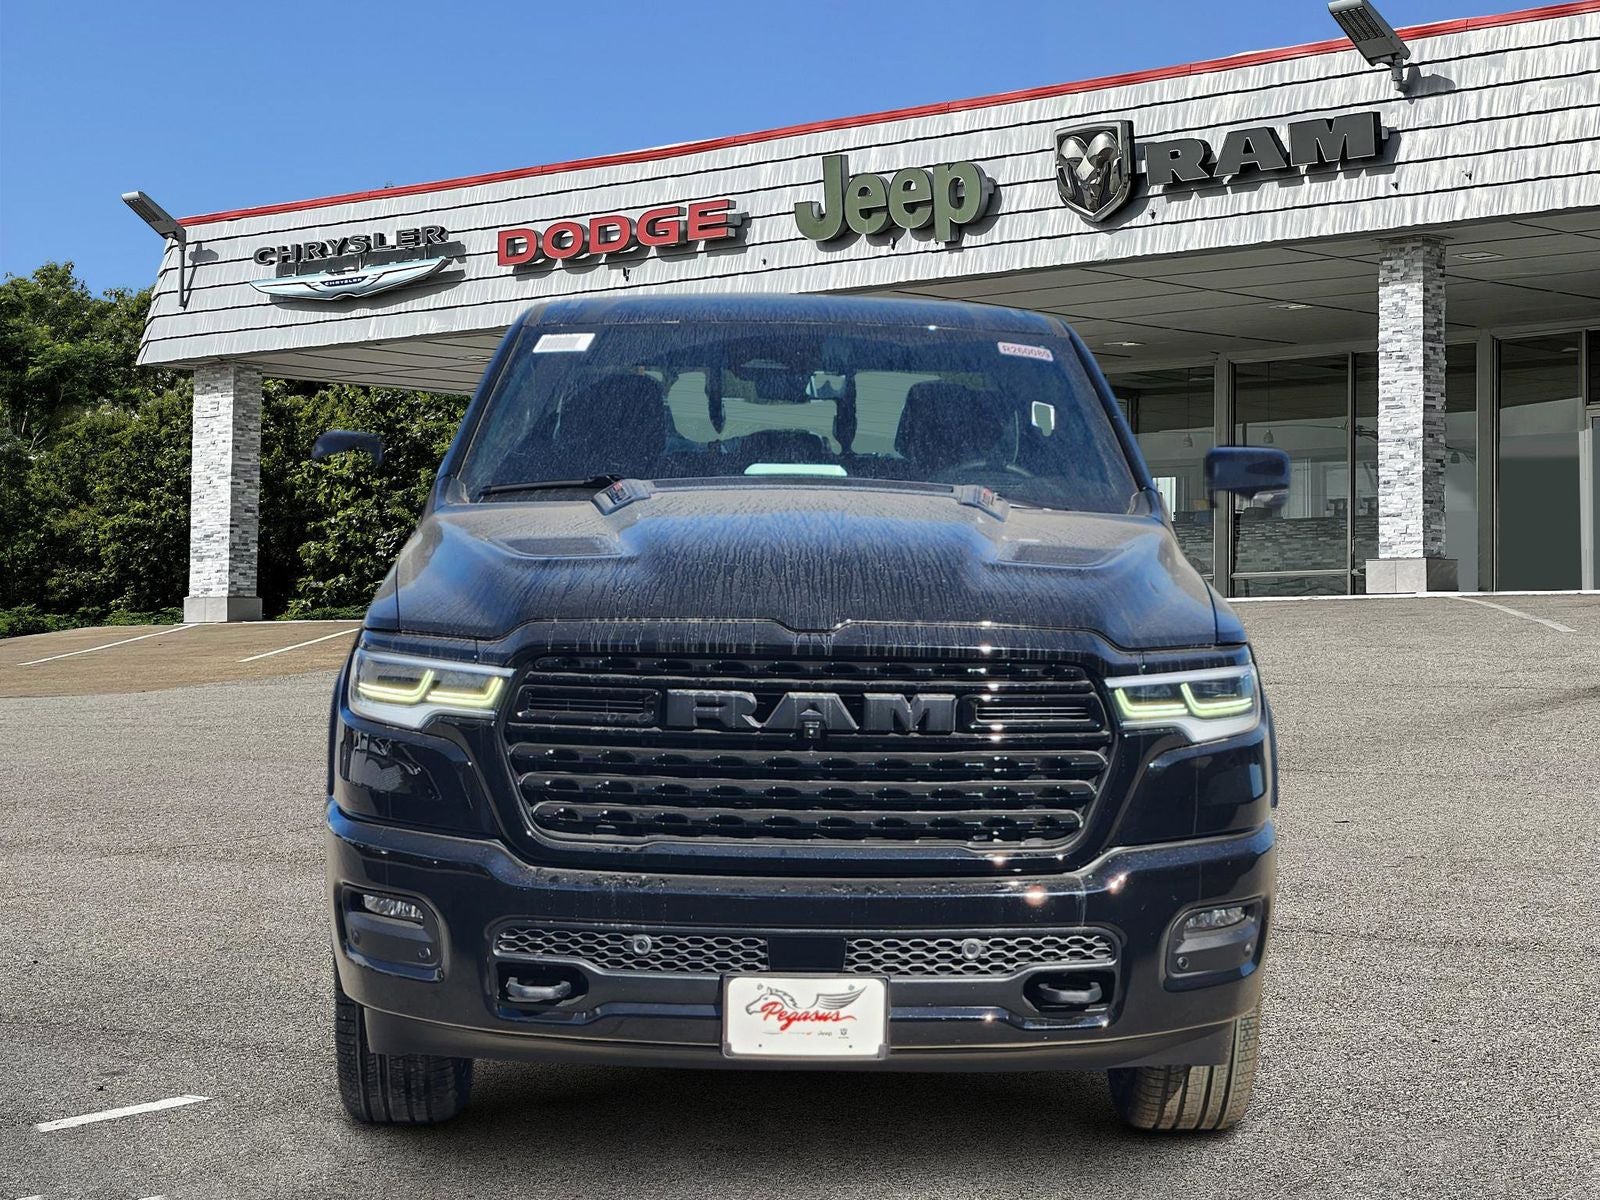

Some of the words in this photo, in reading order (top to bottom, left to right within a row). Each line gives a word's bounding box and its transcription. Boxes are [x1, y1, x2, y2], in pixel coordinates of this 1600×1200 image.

[1144, 111, 1380, 186] RAM
[794, 154, 987, 242] Jeep
[253, 225, 446, 267] CHRYSLER
[497, 199, 735, 267] DODGE
[324, 276, 363, 286] CHRYSLER
[667, 689, 957, 732] RAM
[761, 1001, 857, 1031] Pegasus
